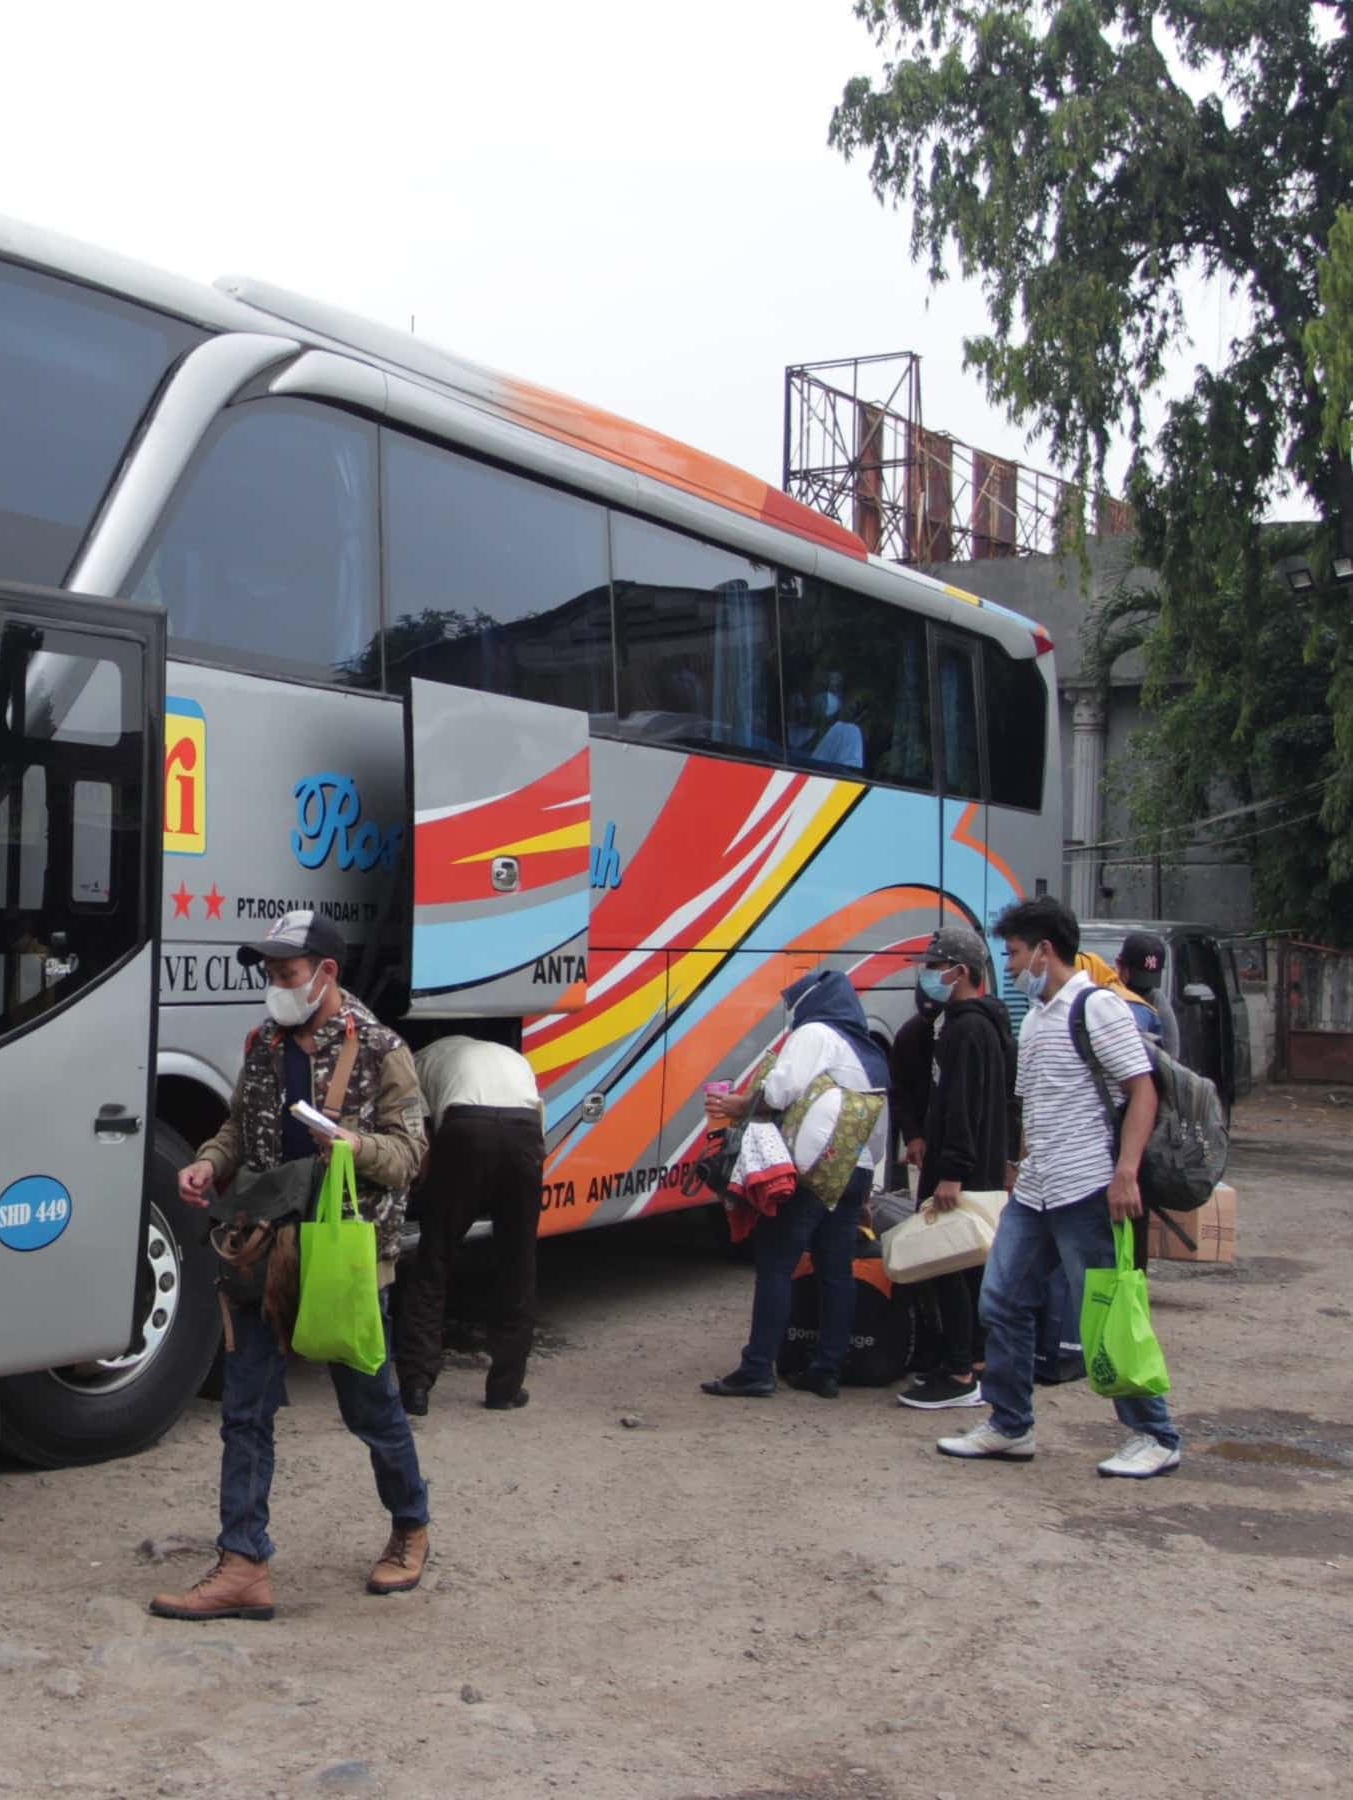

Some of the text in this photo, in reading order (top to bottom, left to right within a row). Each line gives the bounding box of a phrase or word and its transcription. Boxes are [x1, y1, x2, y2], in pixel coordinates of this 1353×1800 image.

[159, 955, 198, 992] VE
[532, 956, 588, 985] ANTA
[587, 1160, 697, 1204] ANTARPROP
[35, 1197, 68, 1223] 449
